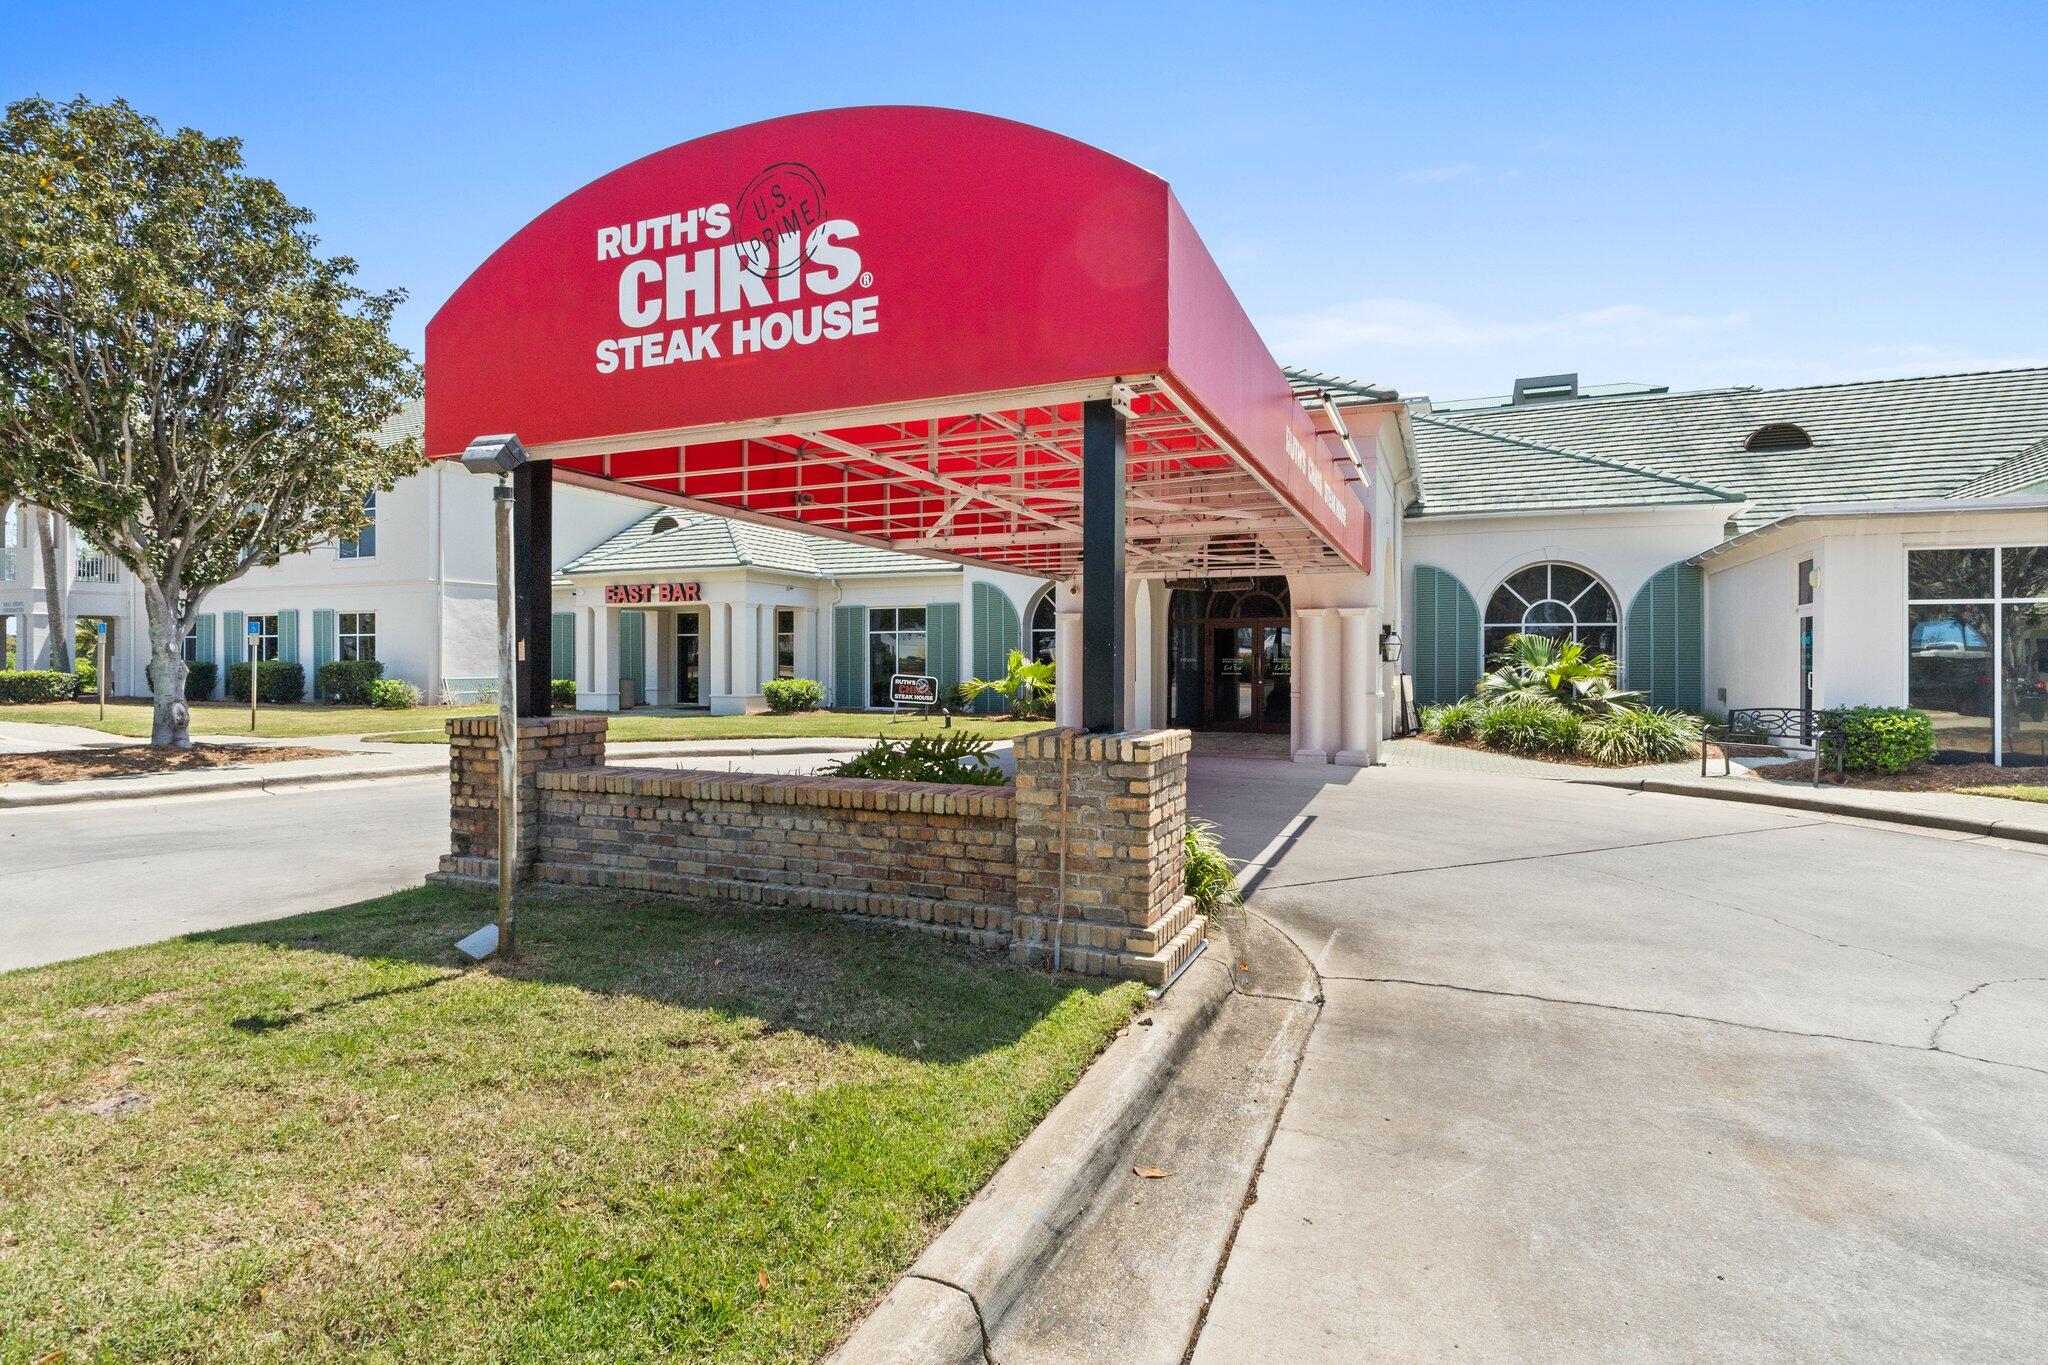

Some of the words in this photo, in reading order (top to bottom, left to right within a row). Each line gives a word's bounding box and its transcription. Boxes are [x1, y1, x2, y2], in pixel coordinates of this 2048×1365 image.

[597, 203, 731, 261] RUTH'S
[750, 199, 814, 262] PRIME
[753, 184, 793, 221] U.S.
[618, 219, 862, 328] CHRIS
[595, 323, 722, 374] STEAK
[732, 295, 879, 355] HOUSE
[604, 584, 655, 603] EAST
[658, 582, 701, 602] BAR
